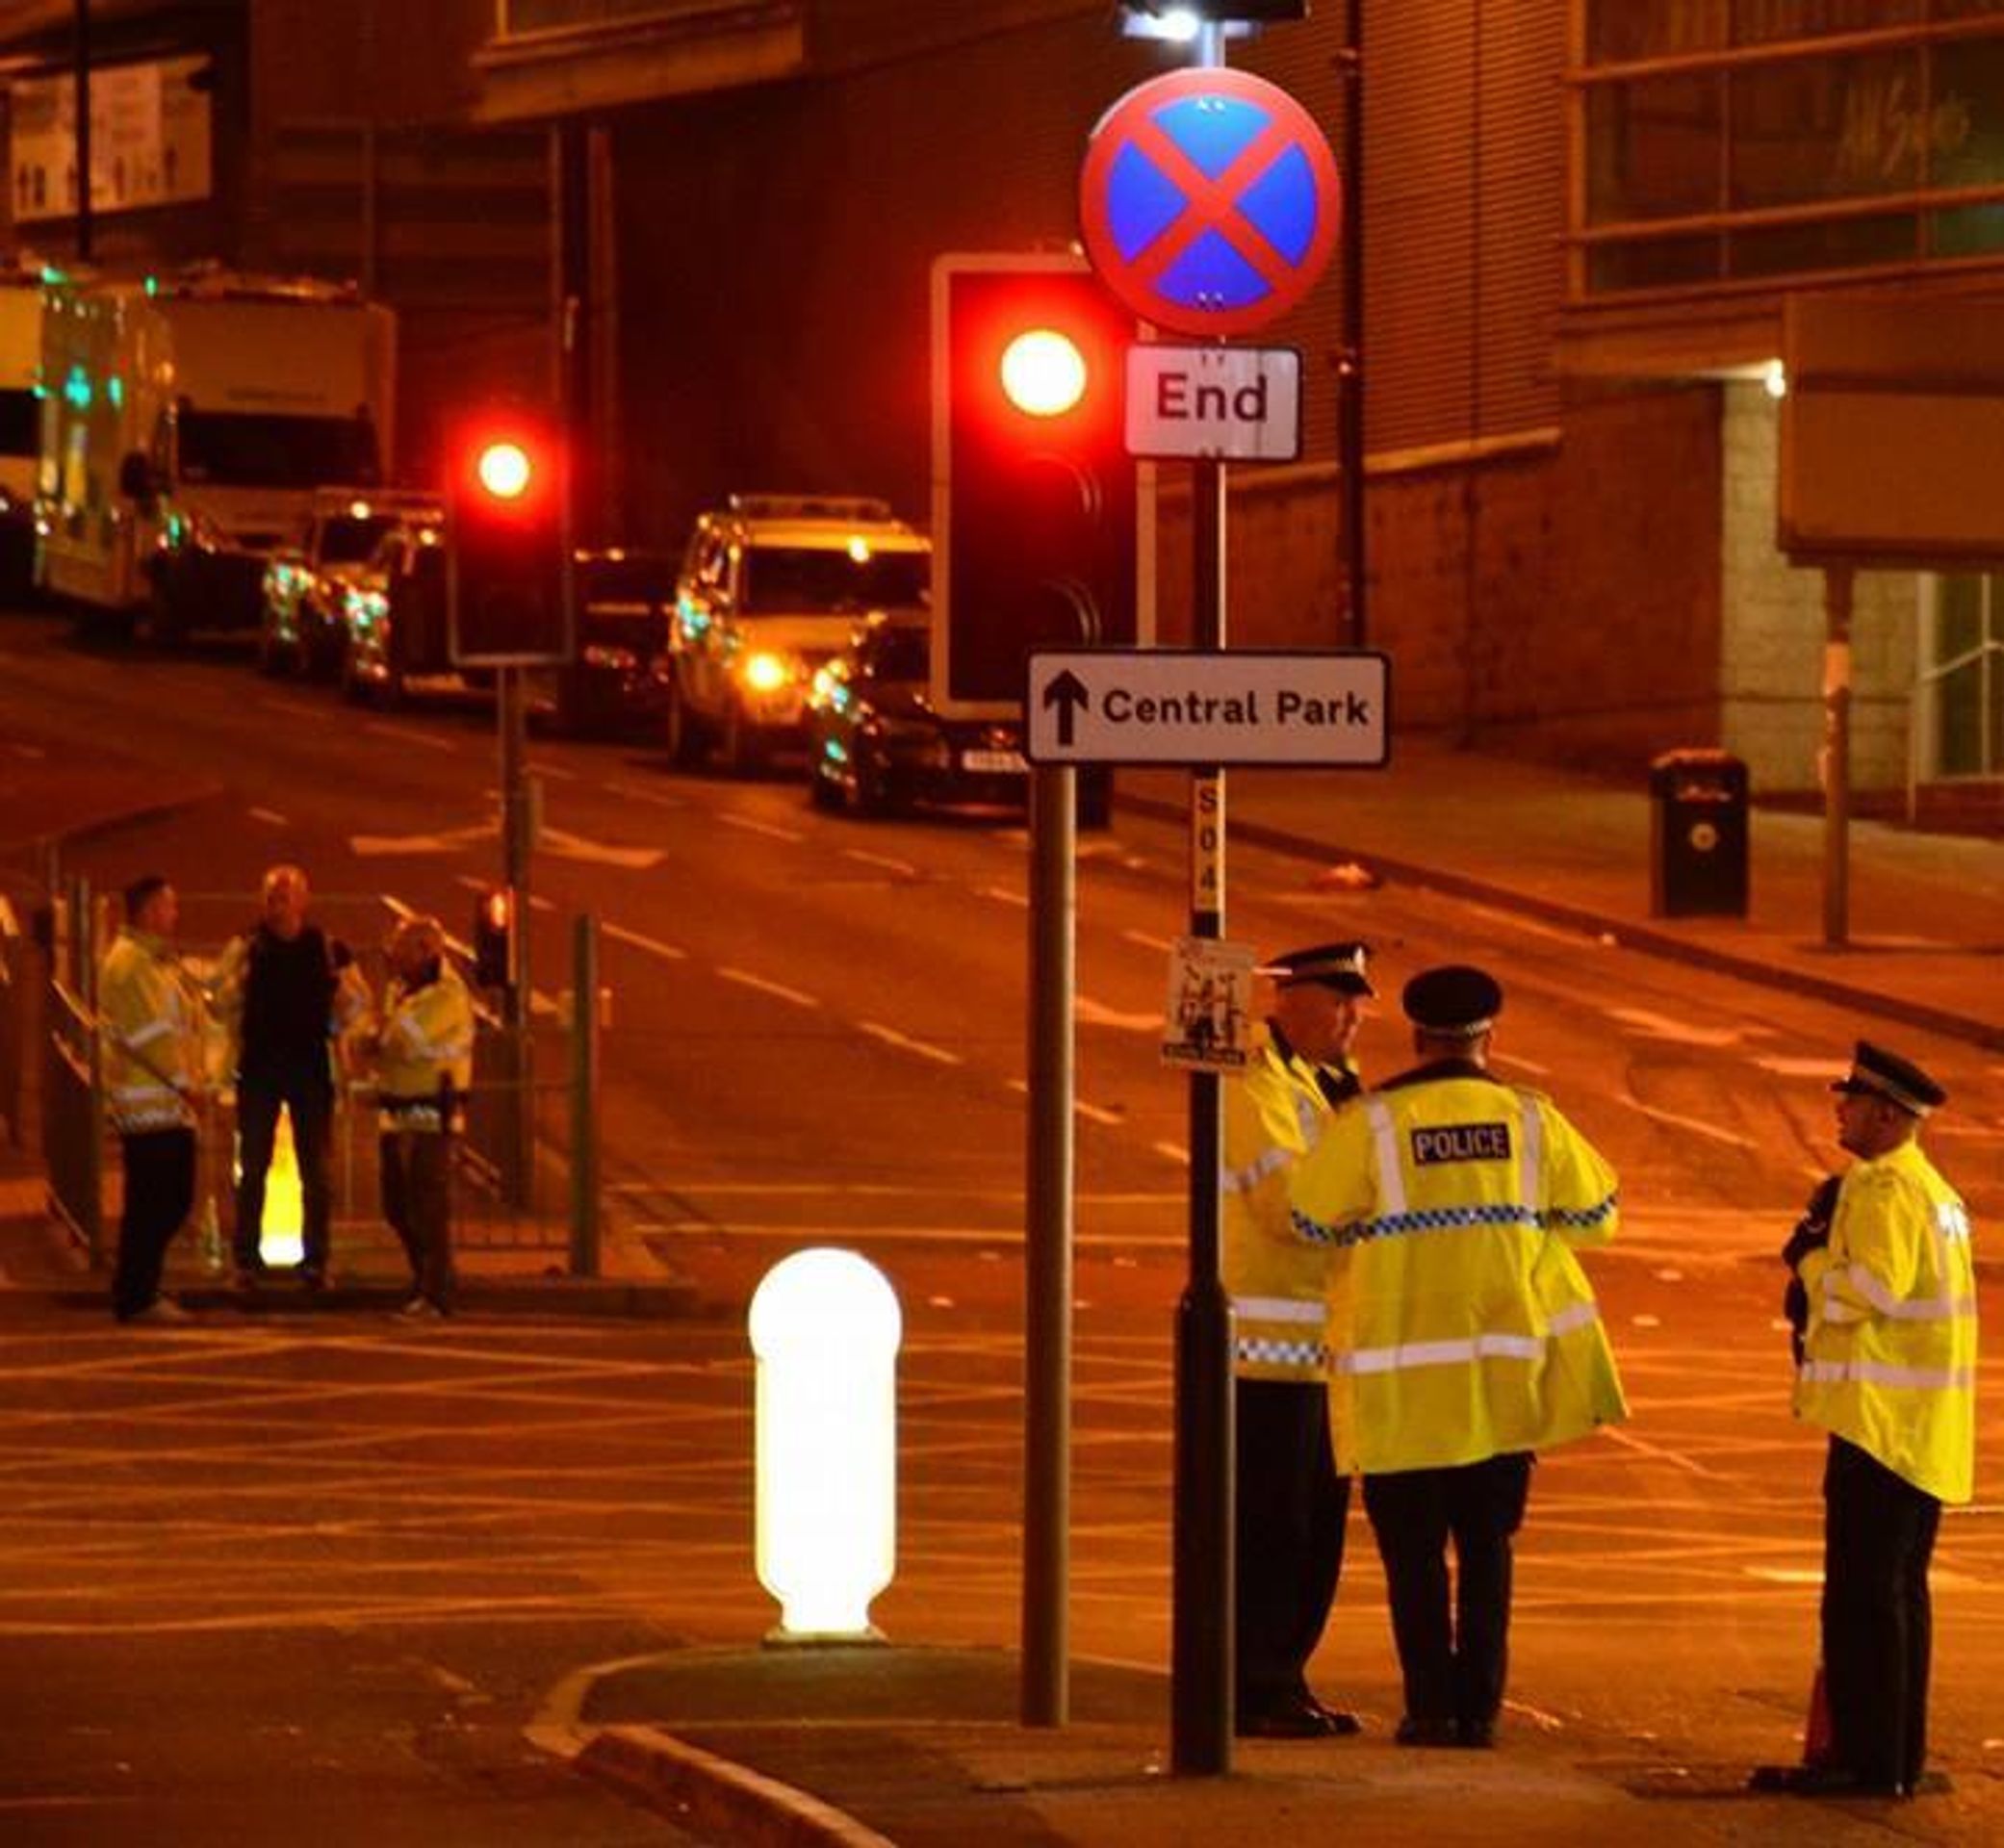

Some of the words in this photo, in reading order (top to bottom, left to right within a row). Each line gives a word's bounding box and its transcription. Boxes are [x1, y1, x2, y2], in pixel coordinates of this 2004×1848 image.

[1157, 372, 1268, 423] End
[1102, 689, 1258, 724] Central
[1276, 690, 1370, 725] Park
[1416, 1129, 1507, 1160] POLICE
